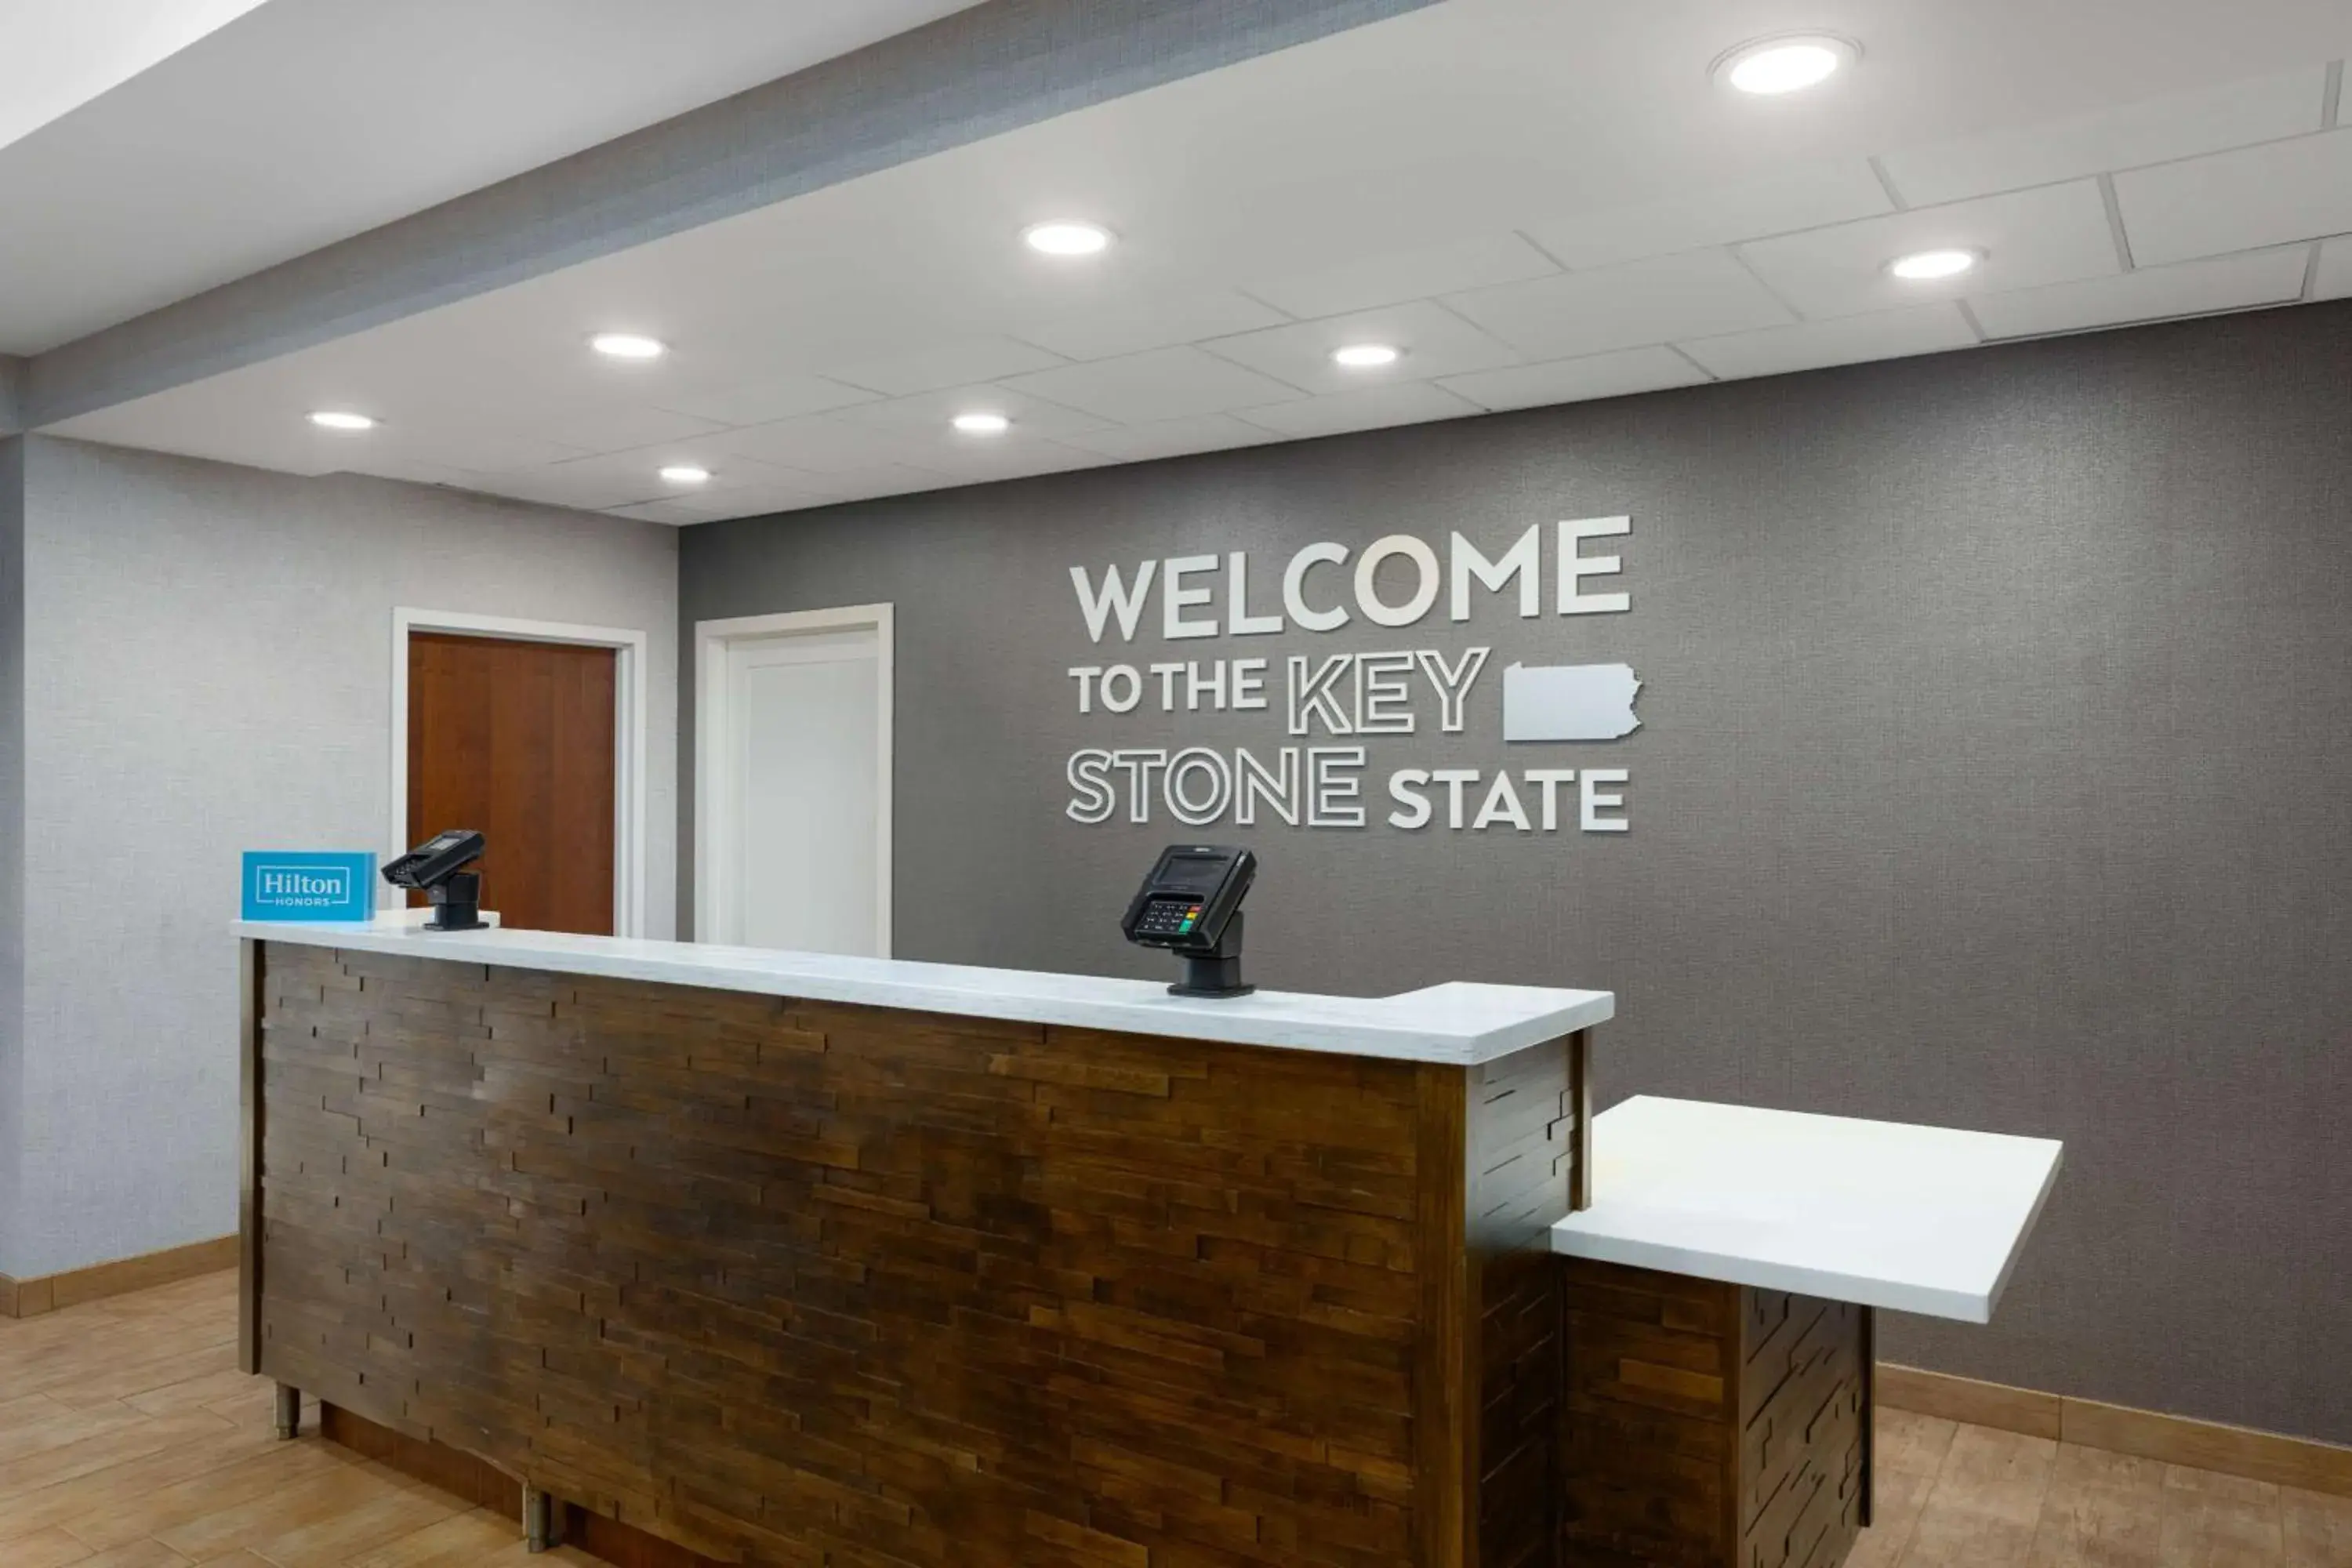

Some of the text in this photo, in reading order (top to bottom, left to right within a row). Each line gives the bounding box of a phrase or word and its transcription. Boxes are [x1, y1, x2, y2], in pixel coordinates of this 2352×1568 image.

[1069, 515, 1632, 643] WELCOME
[1068, 646, 1492, 735] TO THE KEY
[1065, 746, 1630, 832] STONE STATE
[265, 873, 342, 895] Hilton
[275, 898, 331, 907] HONORS
